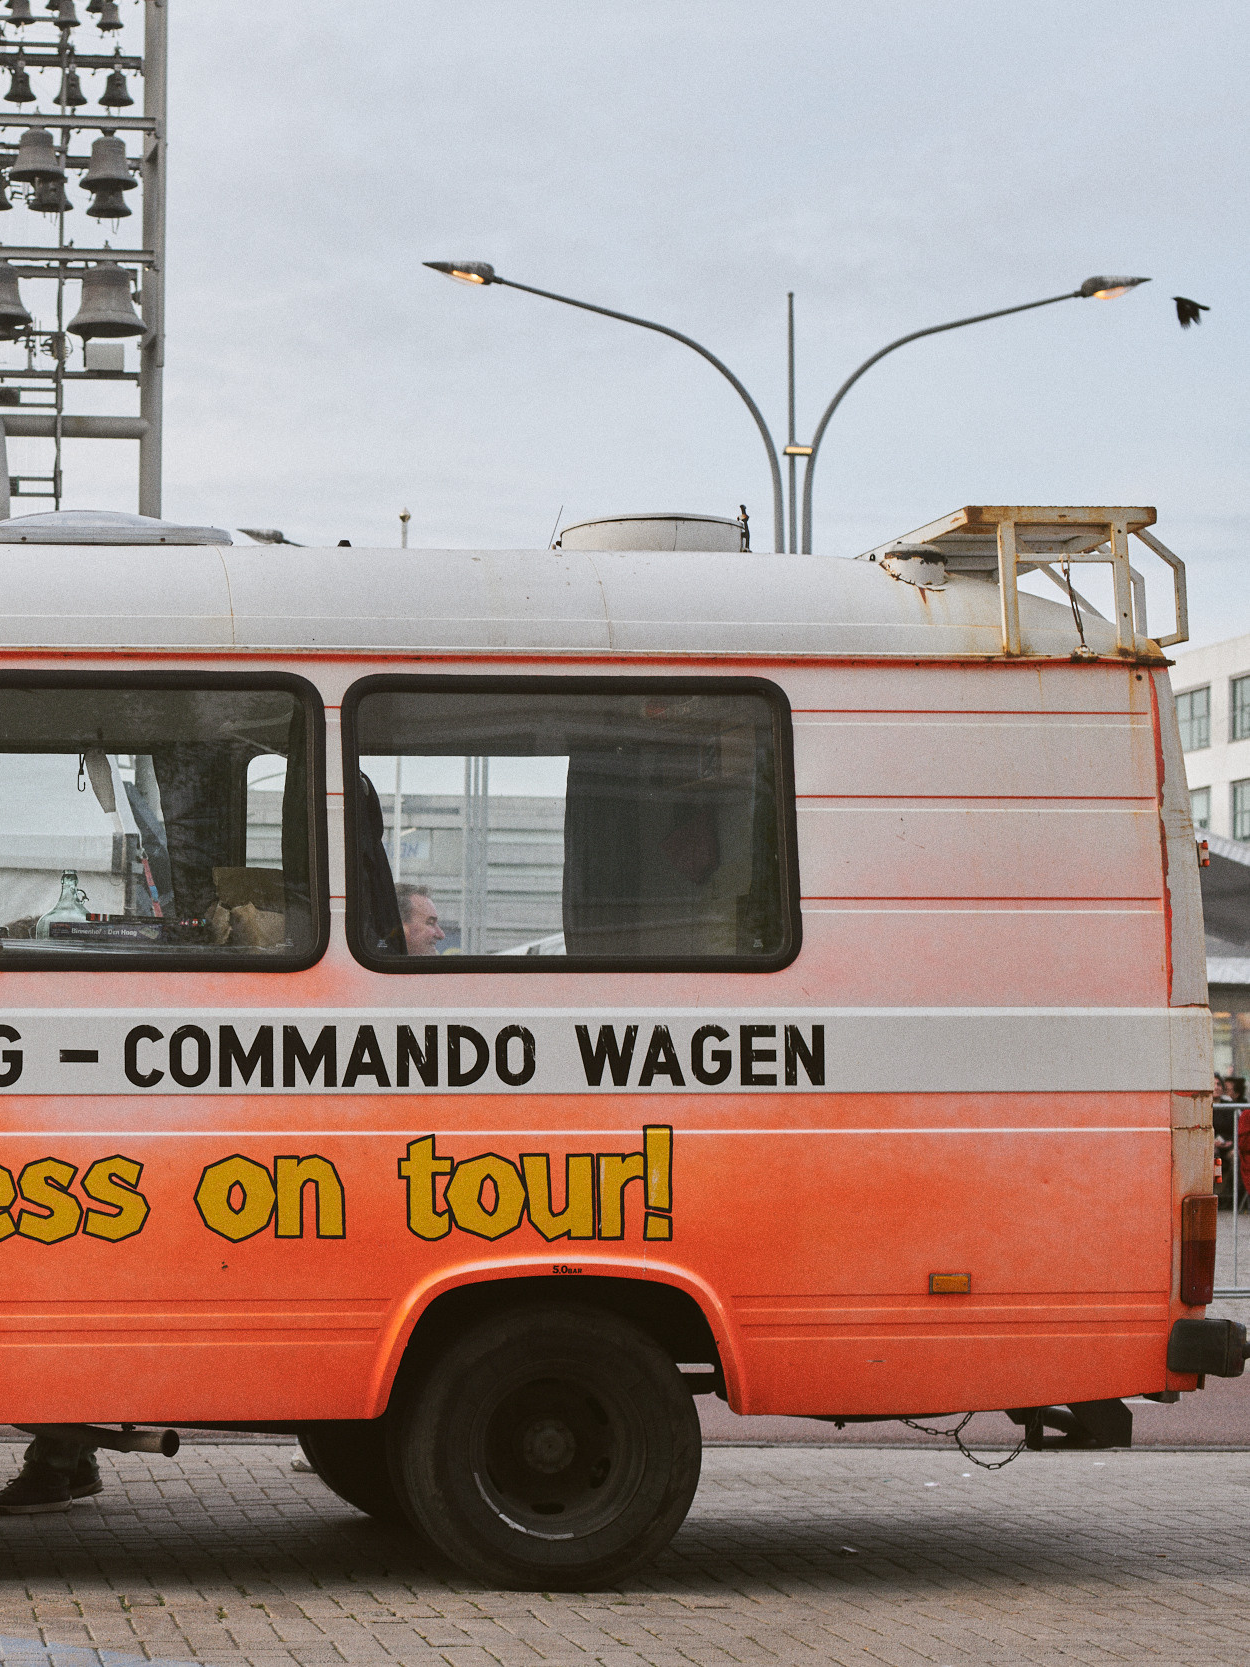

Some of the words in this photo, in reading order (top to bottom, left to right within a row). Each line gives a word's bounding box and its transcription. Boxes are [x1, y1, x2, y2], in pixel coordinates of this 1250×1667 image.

[125, 1024, 535, 1088] COMMANDO
[575, 1024, 826, 1087] WAGEN
[193, 1154, 346, 1243] on
[398, 1124, 674, 1242] tour!
